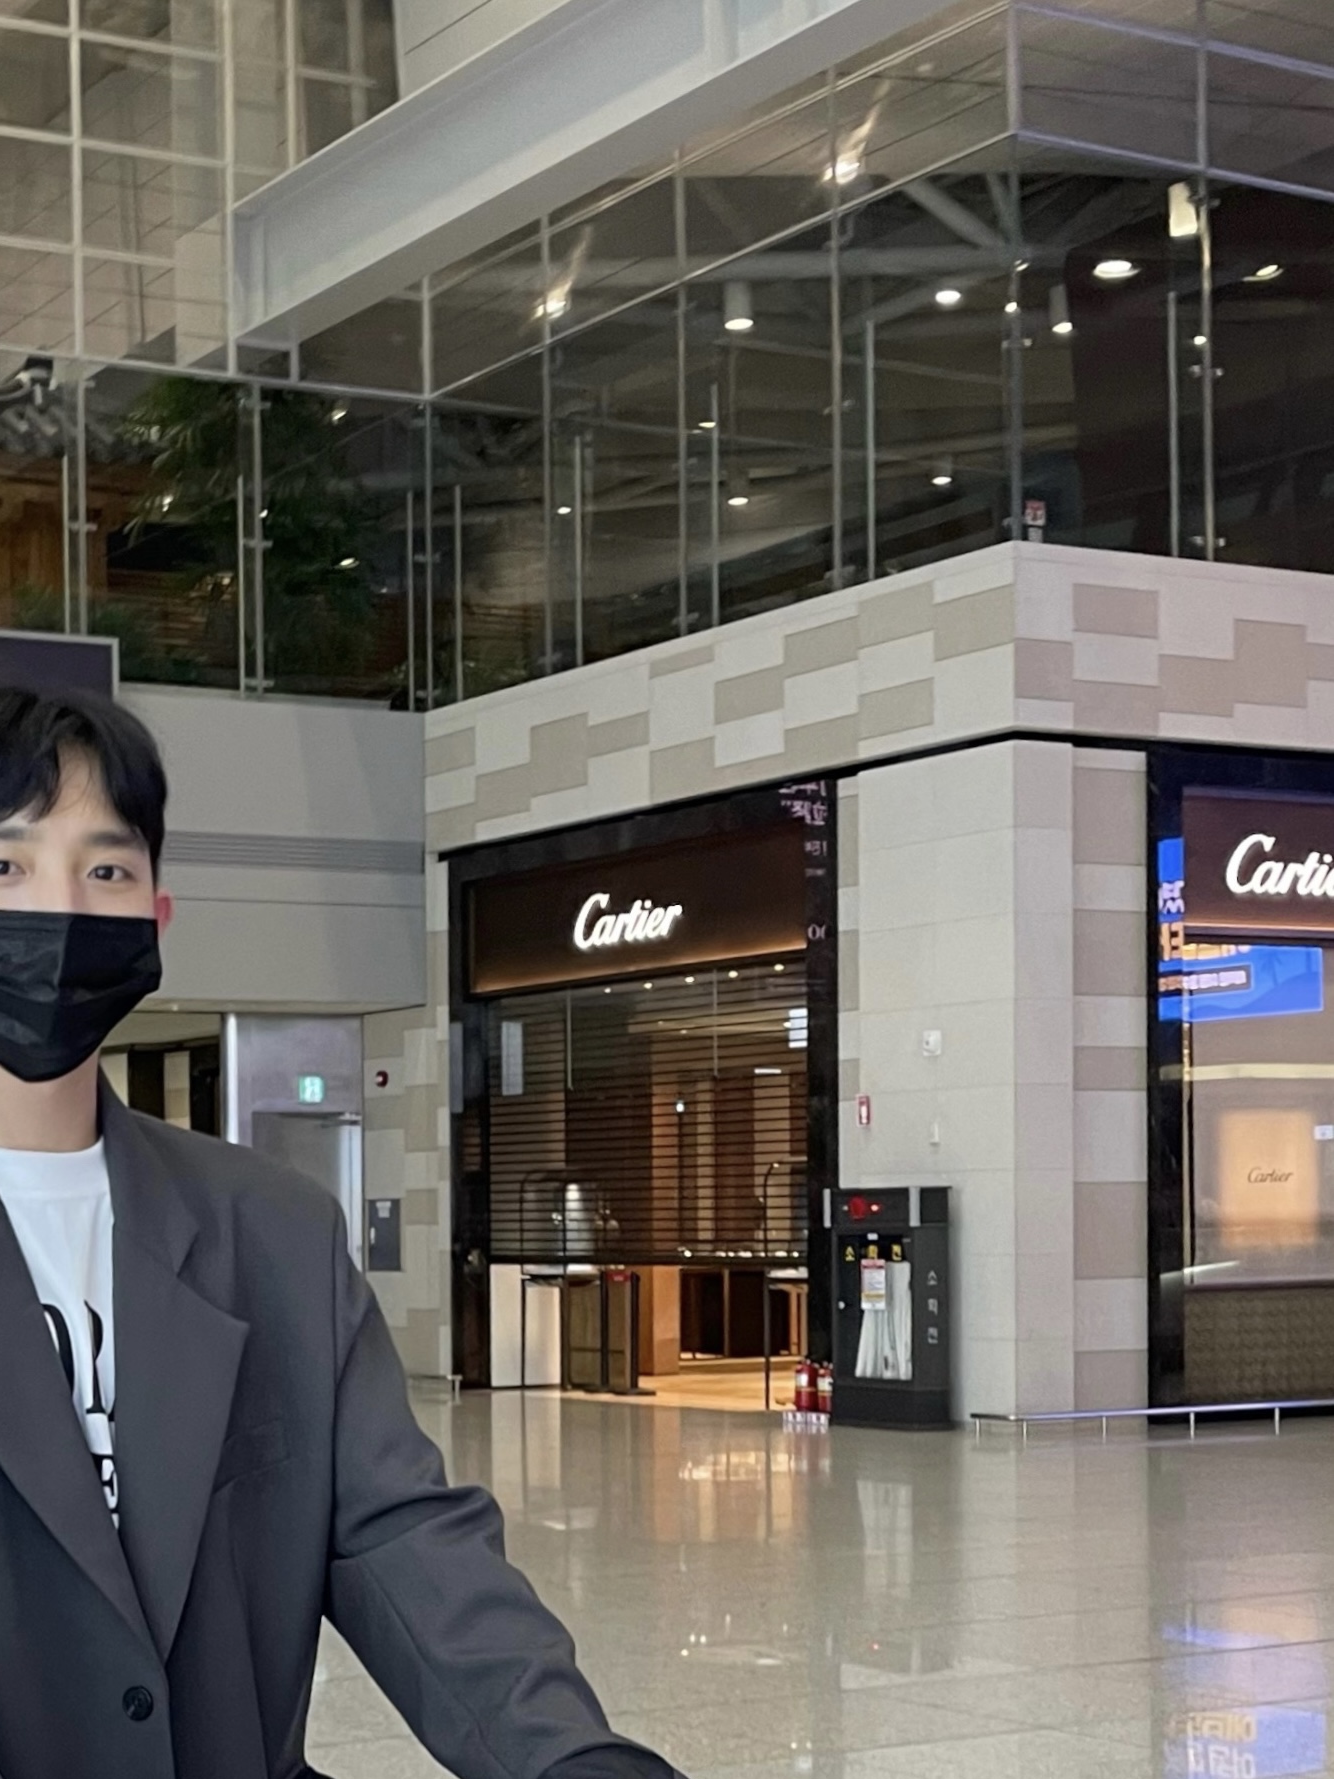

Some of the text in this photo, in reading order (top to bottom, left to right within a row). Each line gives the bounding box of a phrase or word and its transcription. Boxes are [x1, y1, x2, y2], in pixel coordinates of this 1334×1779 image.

[1225, 833, 1334, 897] Carti
[573, 892, 684, 950] Cartier
[1247, 1166, 1294, 1184] Cartier
